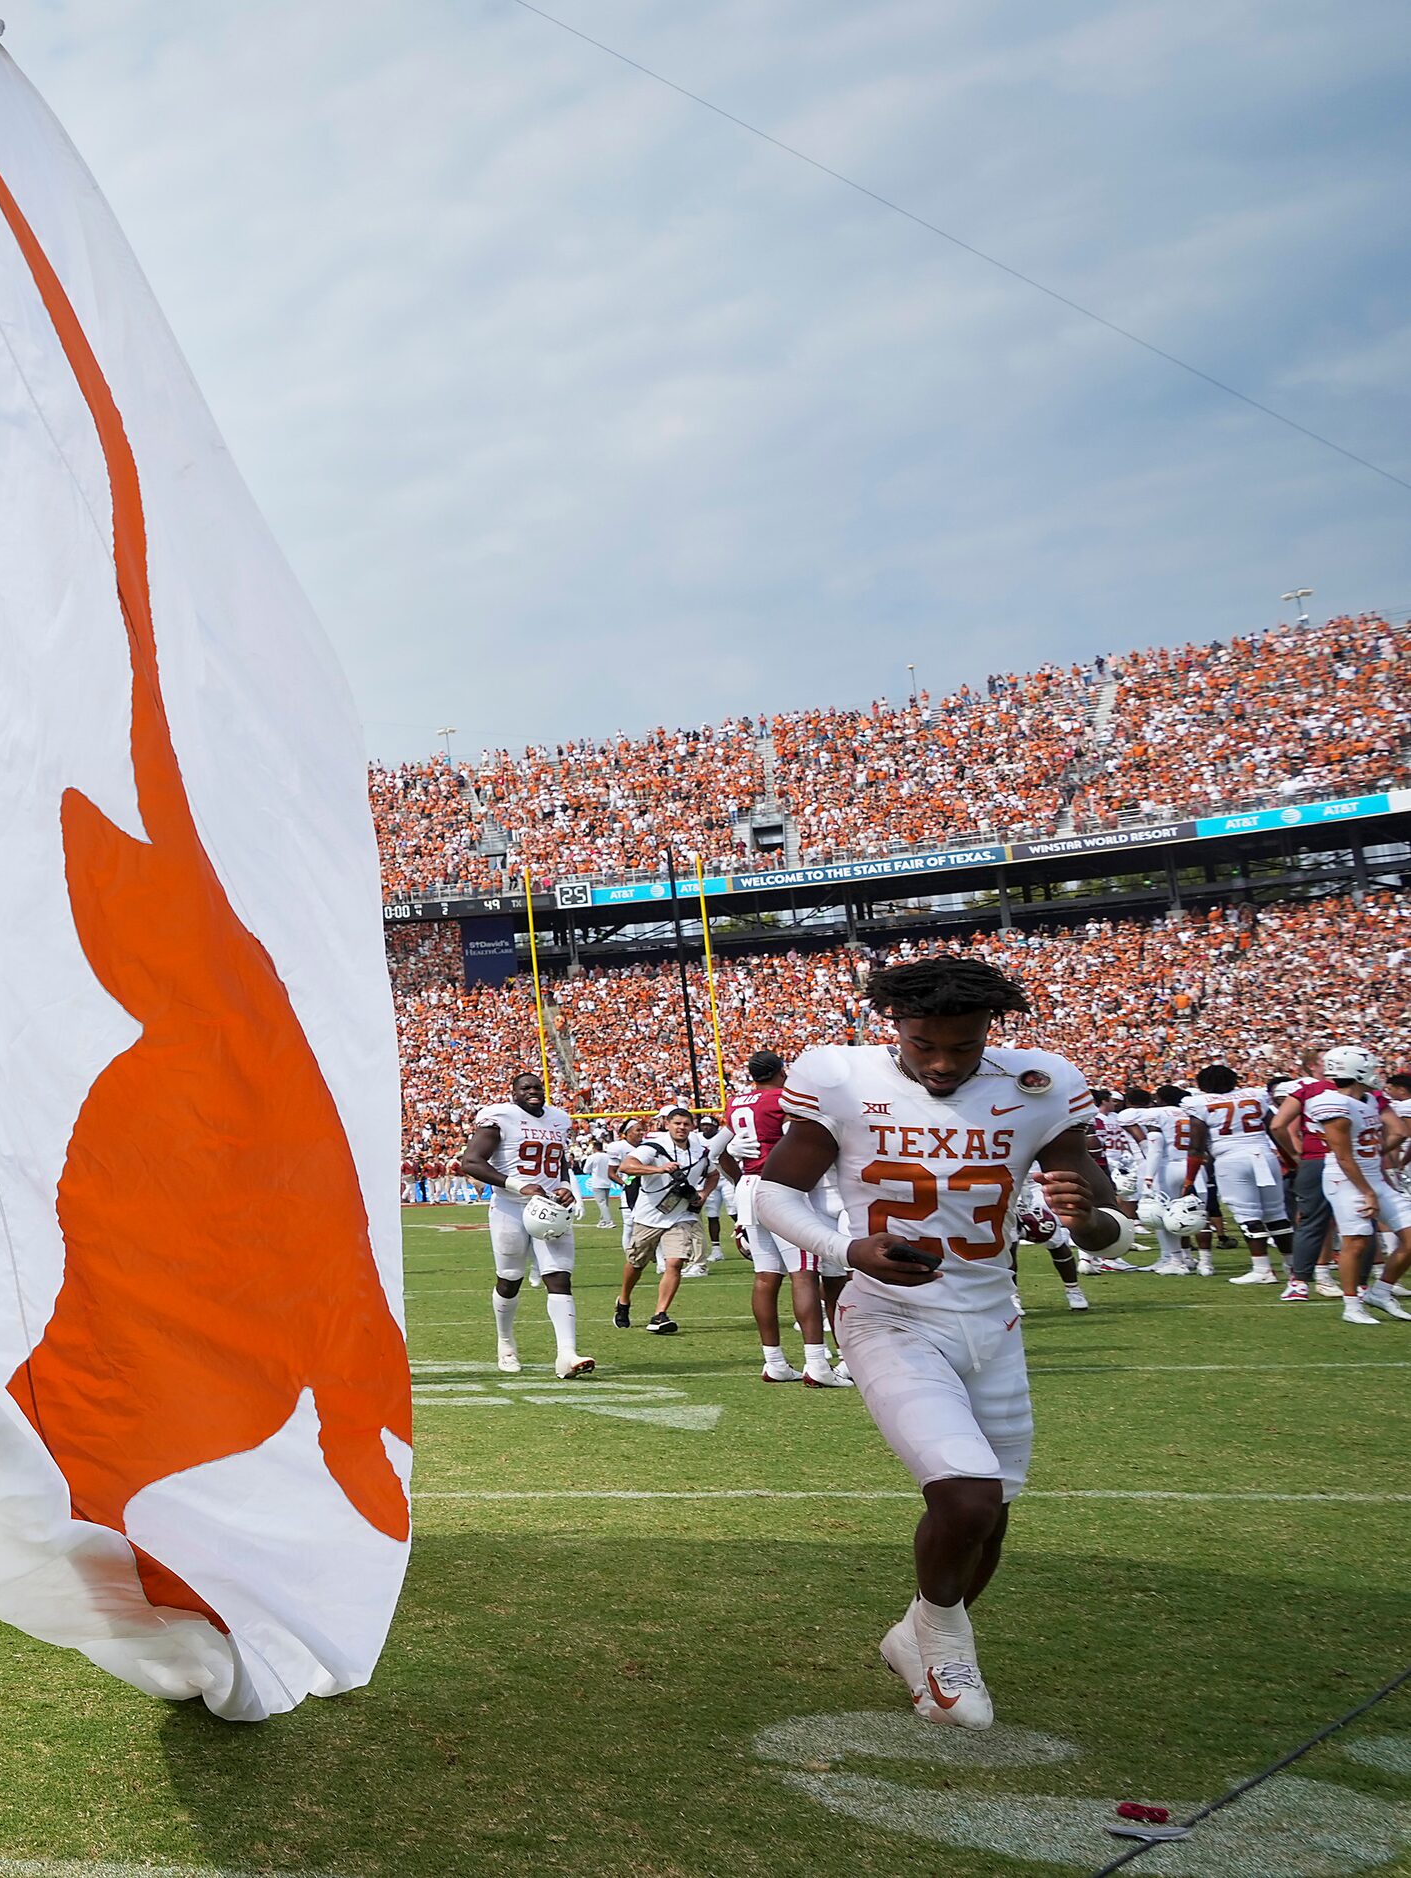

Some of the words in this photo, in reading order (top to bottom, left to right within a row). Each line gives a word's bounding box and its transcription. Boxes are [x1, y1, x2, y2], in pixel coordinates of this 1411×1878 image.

[1323, 801, 1359, 816] AT&T
[1225, 815, 1260, 830] AT&T
[1029, 840, 1083, 854] WINSTAR
[1083, 834, 1129, 847] WORLD
[1130, 827, 1179, 842] RESORT
[740, 873, 805, 888] WELCOME
[805, 870, 825, 881] TO
[825, 867, 854, 879] THE
[853, 862, 892, 875] STATE
[894, 858, 925, 872] FAIR
[926, 855, 947, 868] OF
[947, 850, 997, 865] TEXAS.
[561, 886, 587, 905] 25
[609, 889, 635, 900] AT&T
[442, 907, 449, 916] 2
[483, 898, 501, 911] 49
[1205, 1098, 1265, 1136] 72
[521, 1127, 563, 1141] TEXAS
[869, 1124, 1015, 1160] TEXAS
[516, 1140, 565, 1179] 98
[861, 1159, 1015, 1262] 23
